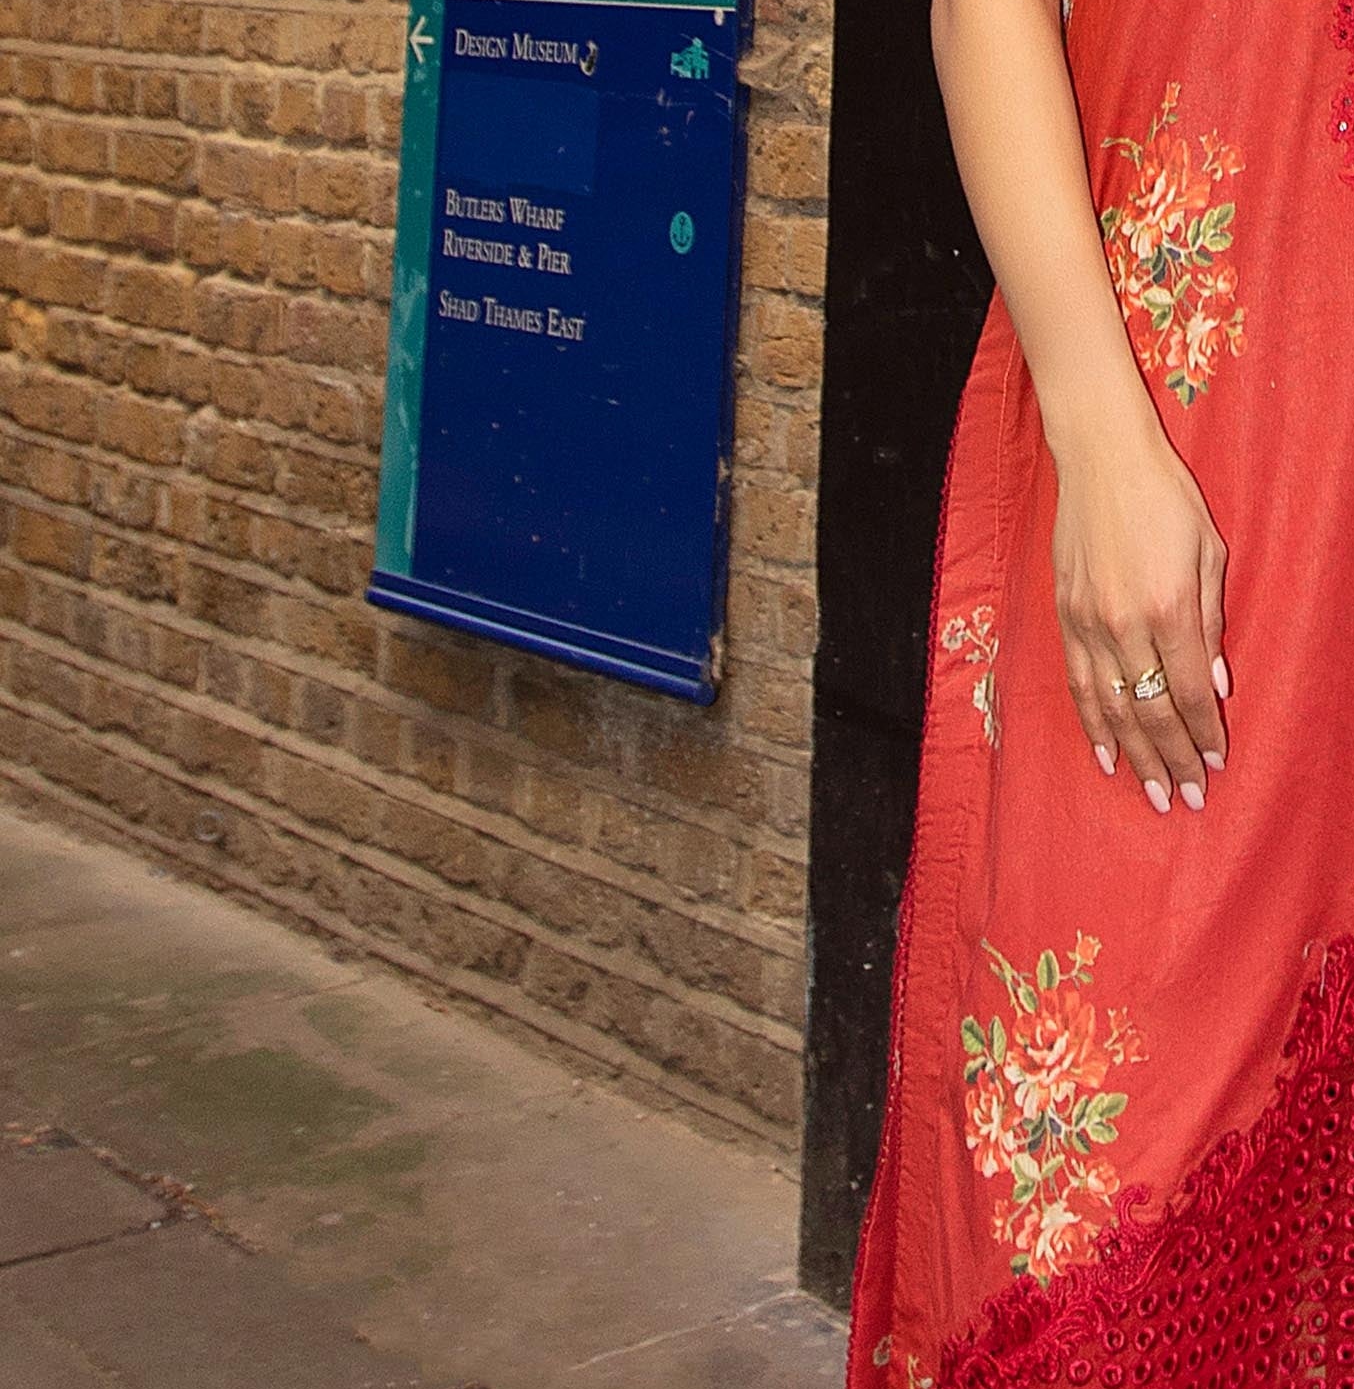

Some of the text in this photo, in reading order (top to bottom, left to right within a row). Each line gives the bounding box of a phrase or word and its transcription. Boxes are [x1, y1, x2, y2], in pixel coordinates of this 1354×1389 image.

[455, 28, 578, 64] DESIGN MUSEUM
[446, 188, 565, 231] BUTLERS WHARF
[443, 228, 572, 275] RIVERSIDE & PIER
[439, 289, 587, 341] SHAD THAMES EAST
